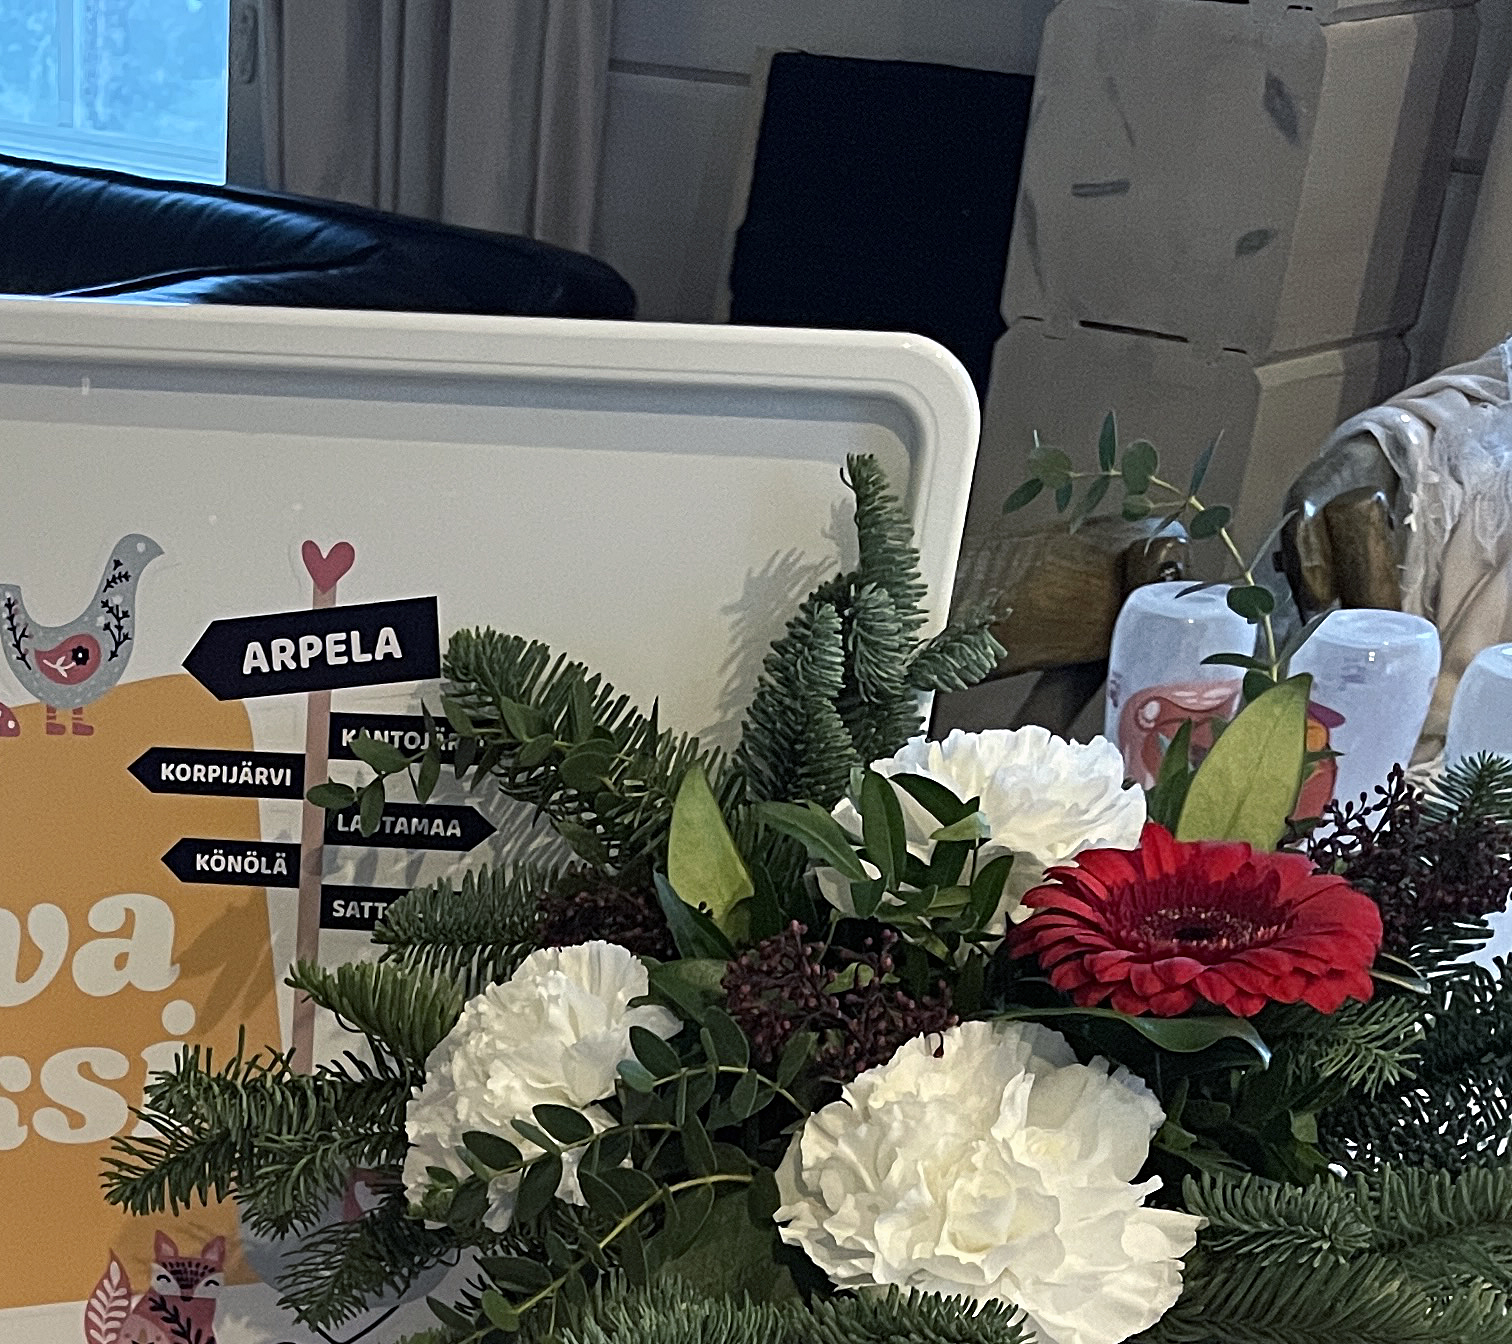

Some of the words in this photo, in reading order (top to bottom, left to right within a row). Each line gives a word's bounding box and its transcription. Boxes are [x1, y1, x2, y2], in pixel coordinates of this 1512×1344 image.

[242, 626, 403, 675] ARPELA
[160, 762, 292, 788] KORPIJÄRVI
[337, 813, 462, 838] LATAMAA
[195, 848, 288, 876] KÖNÖLÄ
